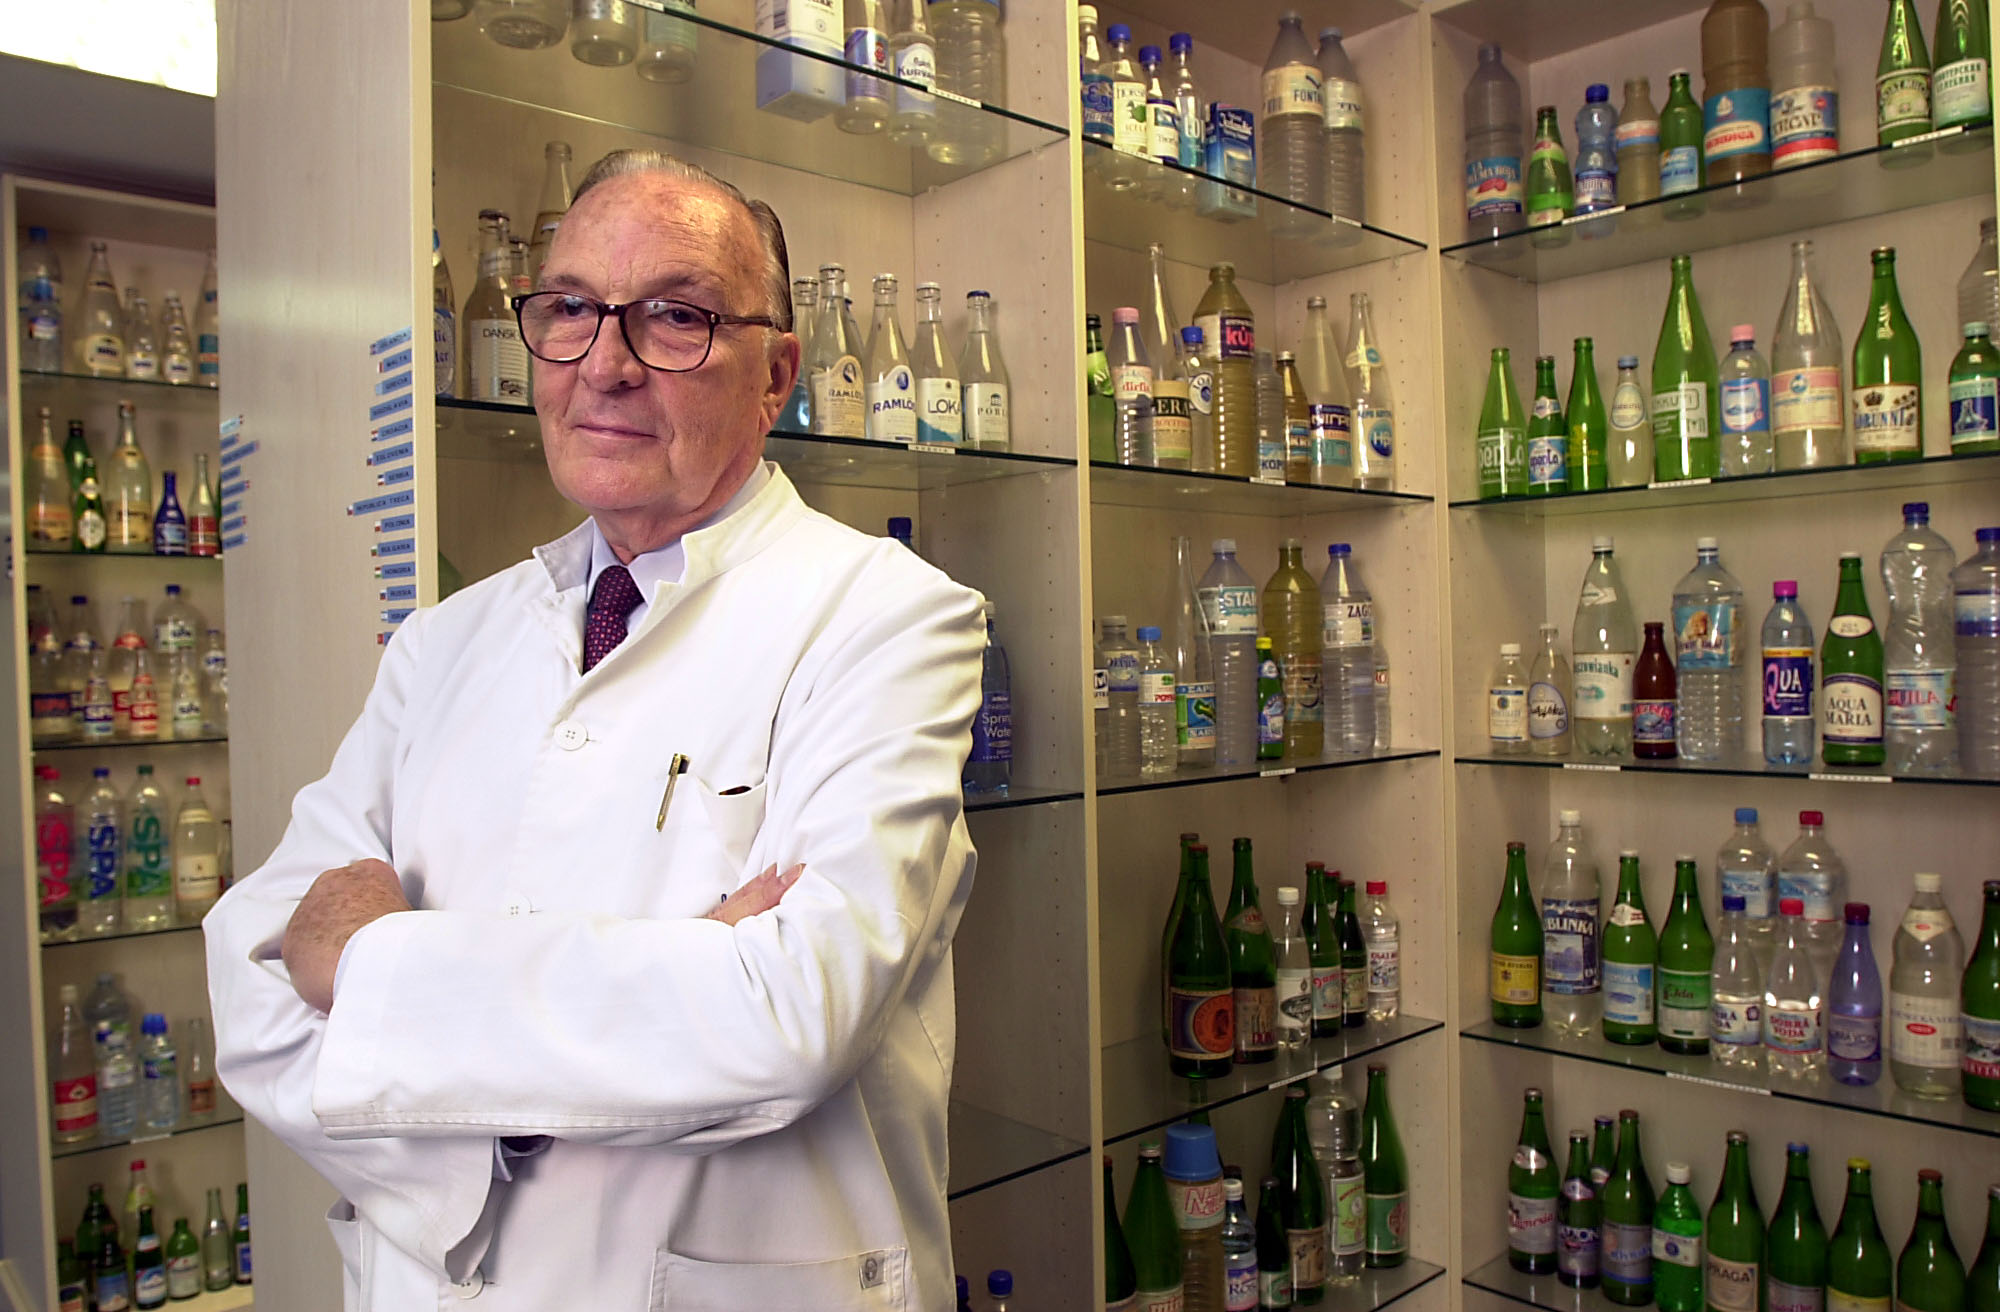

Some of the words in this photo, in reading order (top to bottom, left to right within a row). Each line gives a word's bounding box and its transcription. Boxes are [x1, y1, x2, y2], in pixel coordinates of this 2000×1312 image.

[1825, 707, 1872, 727] MARIA
[1830, 697, 1867, 714] AQUA
[89, 825, 116, 900] SPA
[134, 815, 161, 893] SPA
